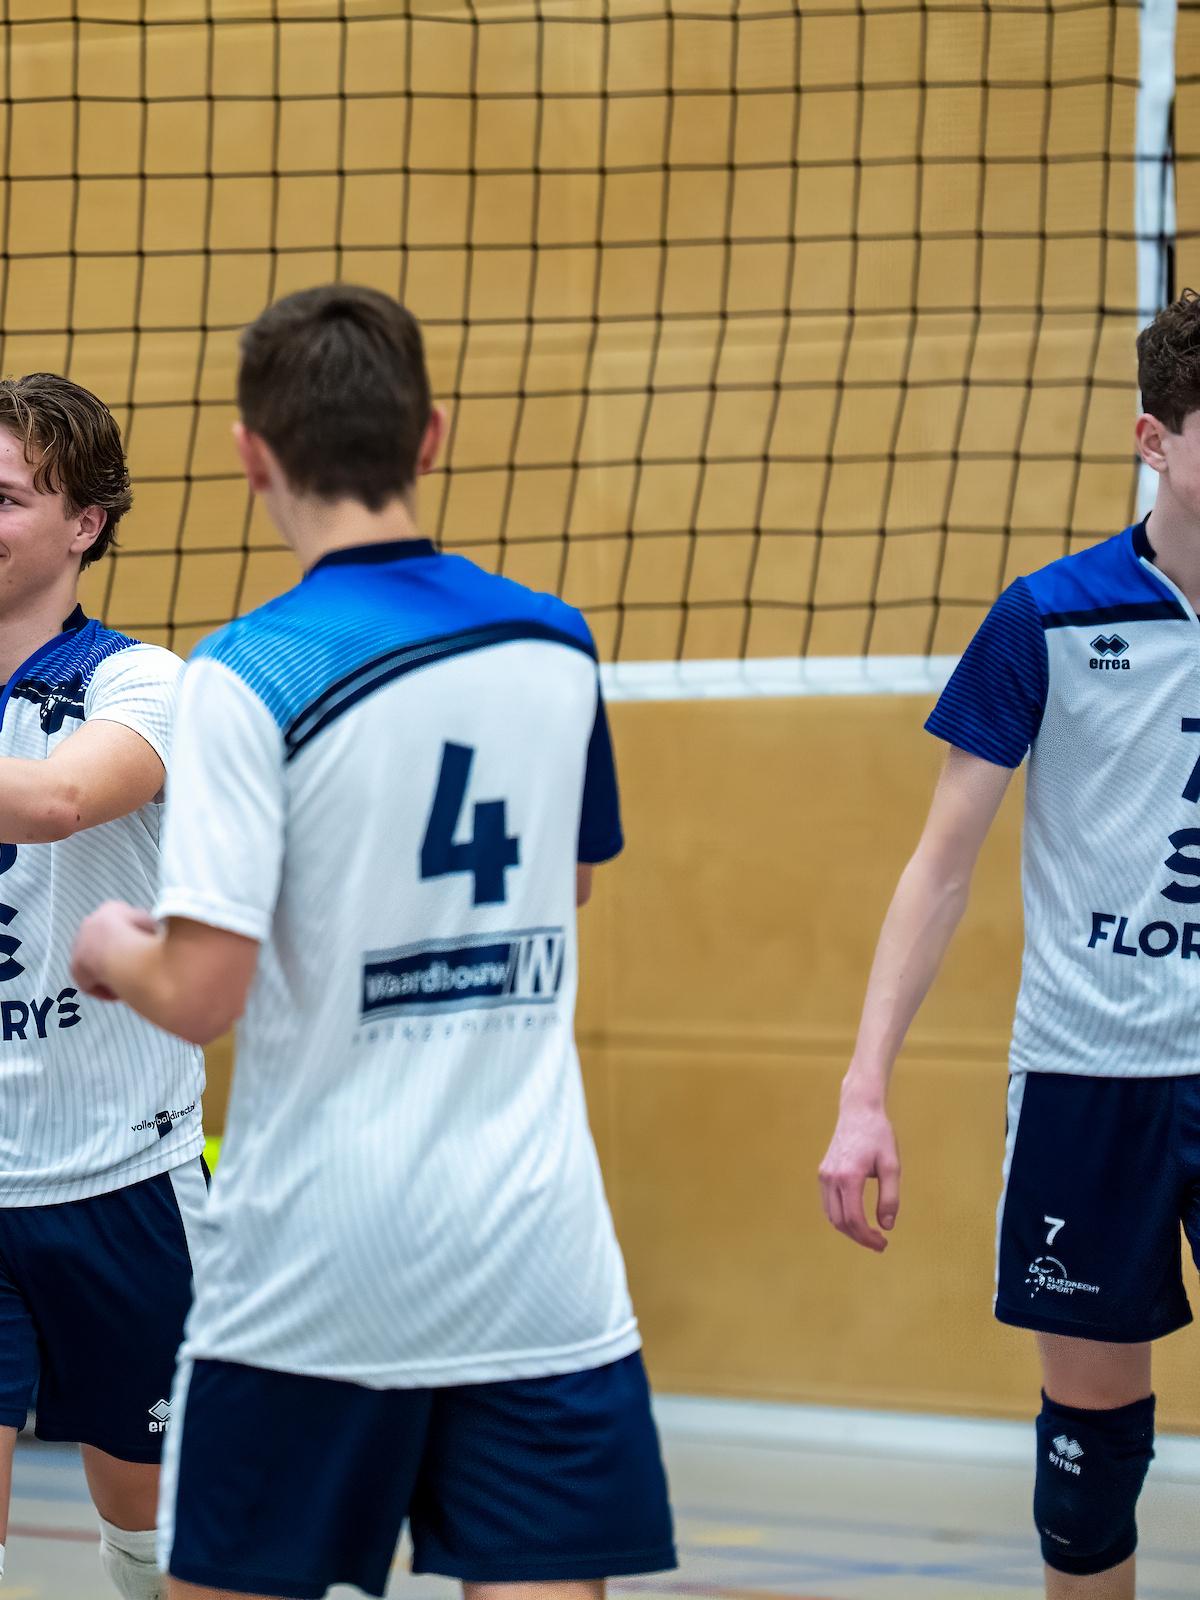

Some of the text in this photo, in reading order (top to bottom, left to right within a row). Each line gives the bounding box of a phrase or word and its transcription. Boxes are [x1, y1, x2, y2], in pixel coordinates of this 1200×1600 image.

[1089, 657, 1130, 670] errea
[419, 739, 521, 908] 4
[1087, 911, 1200, 960] FLOR
[1043, 1215, 1066, 1246] 7
